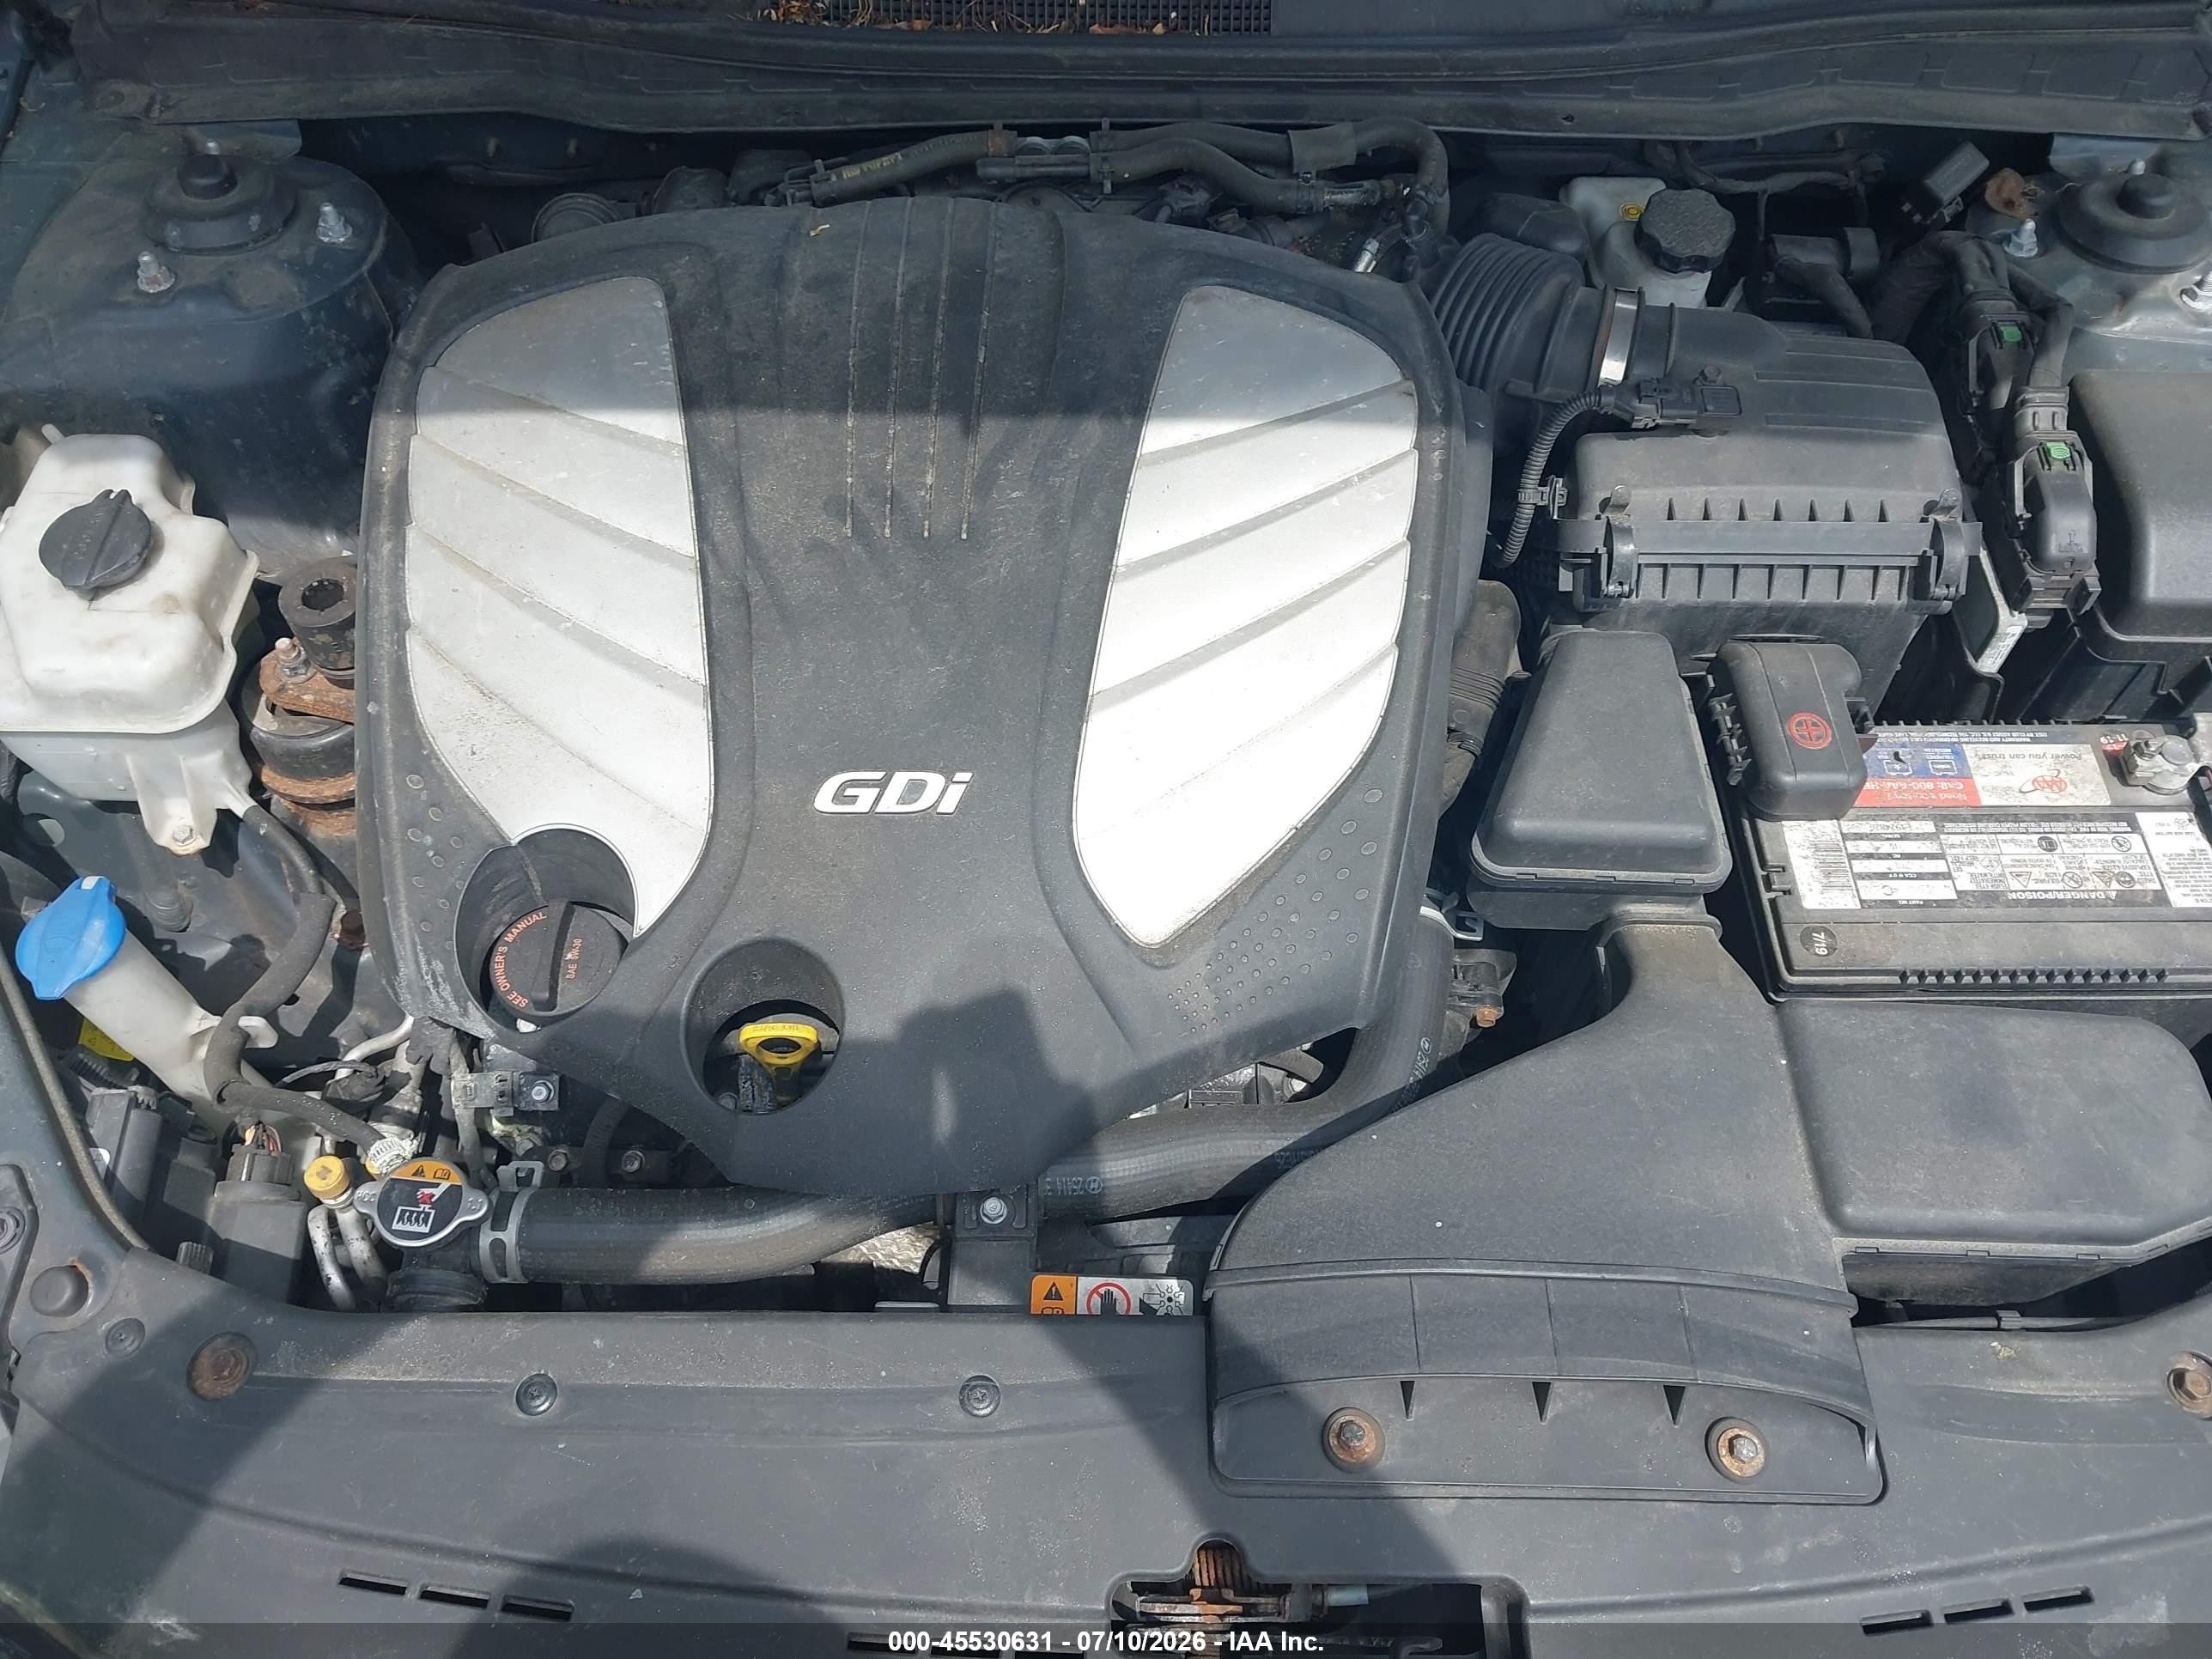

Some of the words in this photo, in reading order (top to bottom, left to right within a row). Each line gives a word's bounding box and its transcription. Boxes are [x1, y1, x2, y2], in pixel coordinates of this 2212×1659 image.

[813, 771, 975, 815] GDi
[504, 911, 548, 943] MANUAL
[571, 939, 583, 960] 5W-30
[1812, 932, 1828, 955] 7/19
[494, 945, 511, 992] OWNER'S
[566, 963, 577, 980] SAE
[507, 990, 528, 1008] SEE
